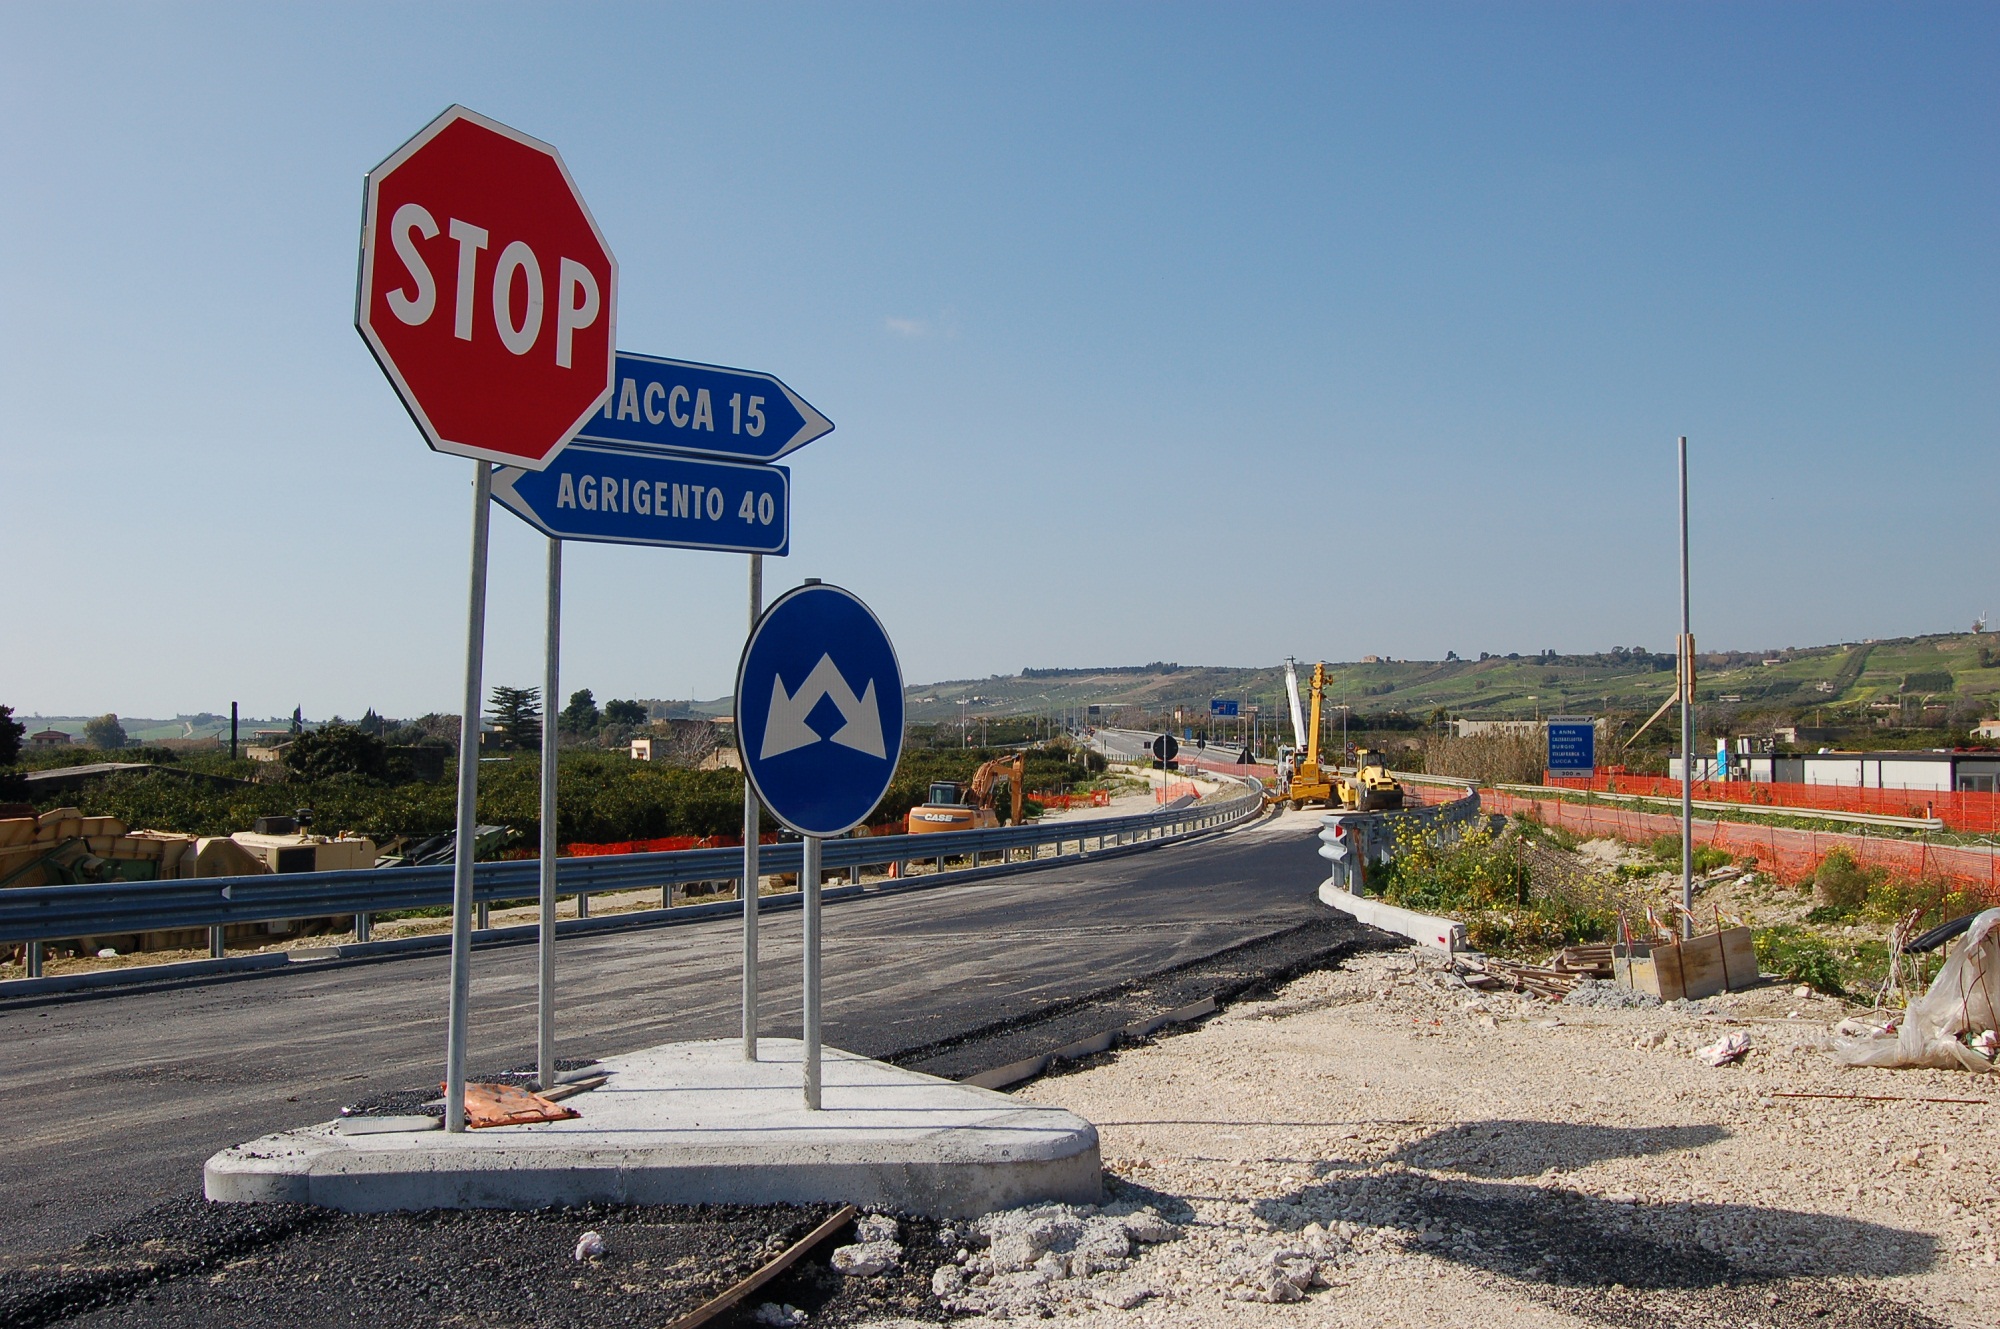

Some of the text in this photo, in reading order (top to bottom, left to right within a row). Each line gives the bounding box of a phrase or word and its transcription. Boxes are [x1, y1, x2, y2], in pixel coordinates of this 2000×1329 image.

[386, 203, 600, 369] STOP
[729, 392, 766, 437] 15
[556, 472, 775, 526] AGRIGENTO 40
[925, 813, 953, 822] CASE
